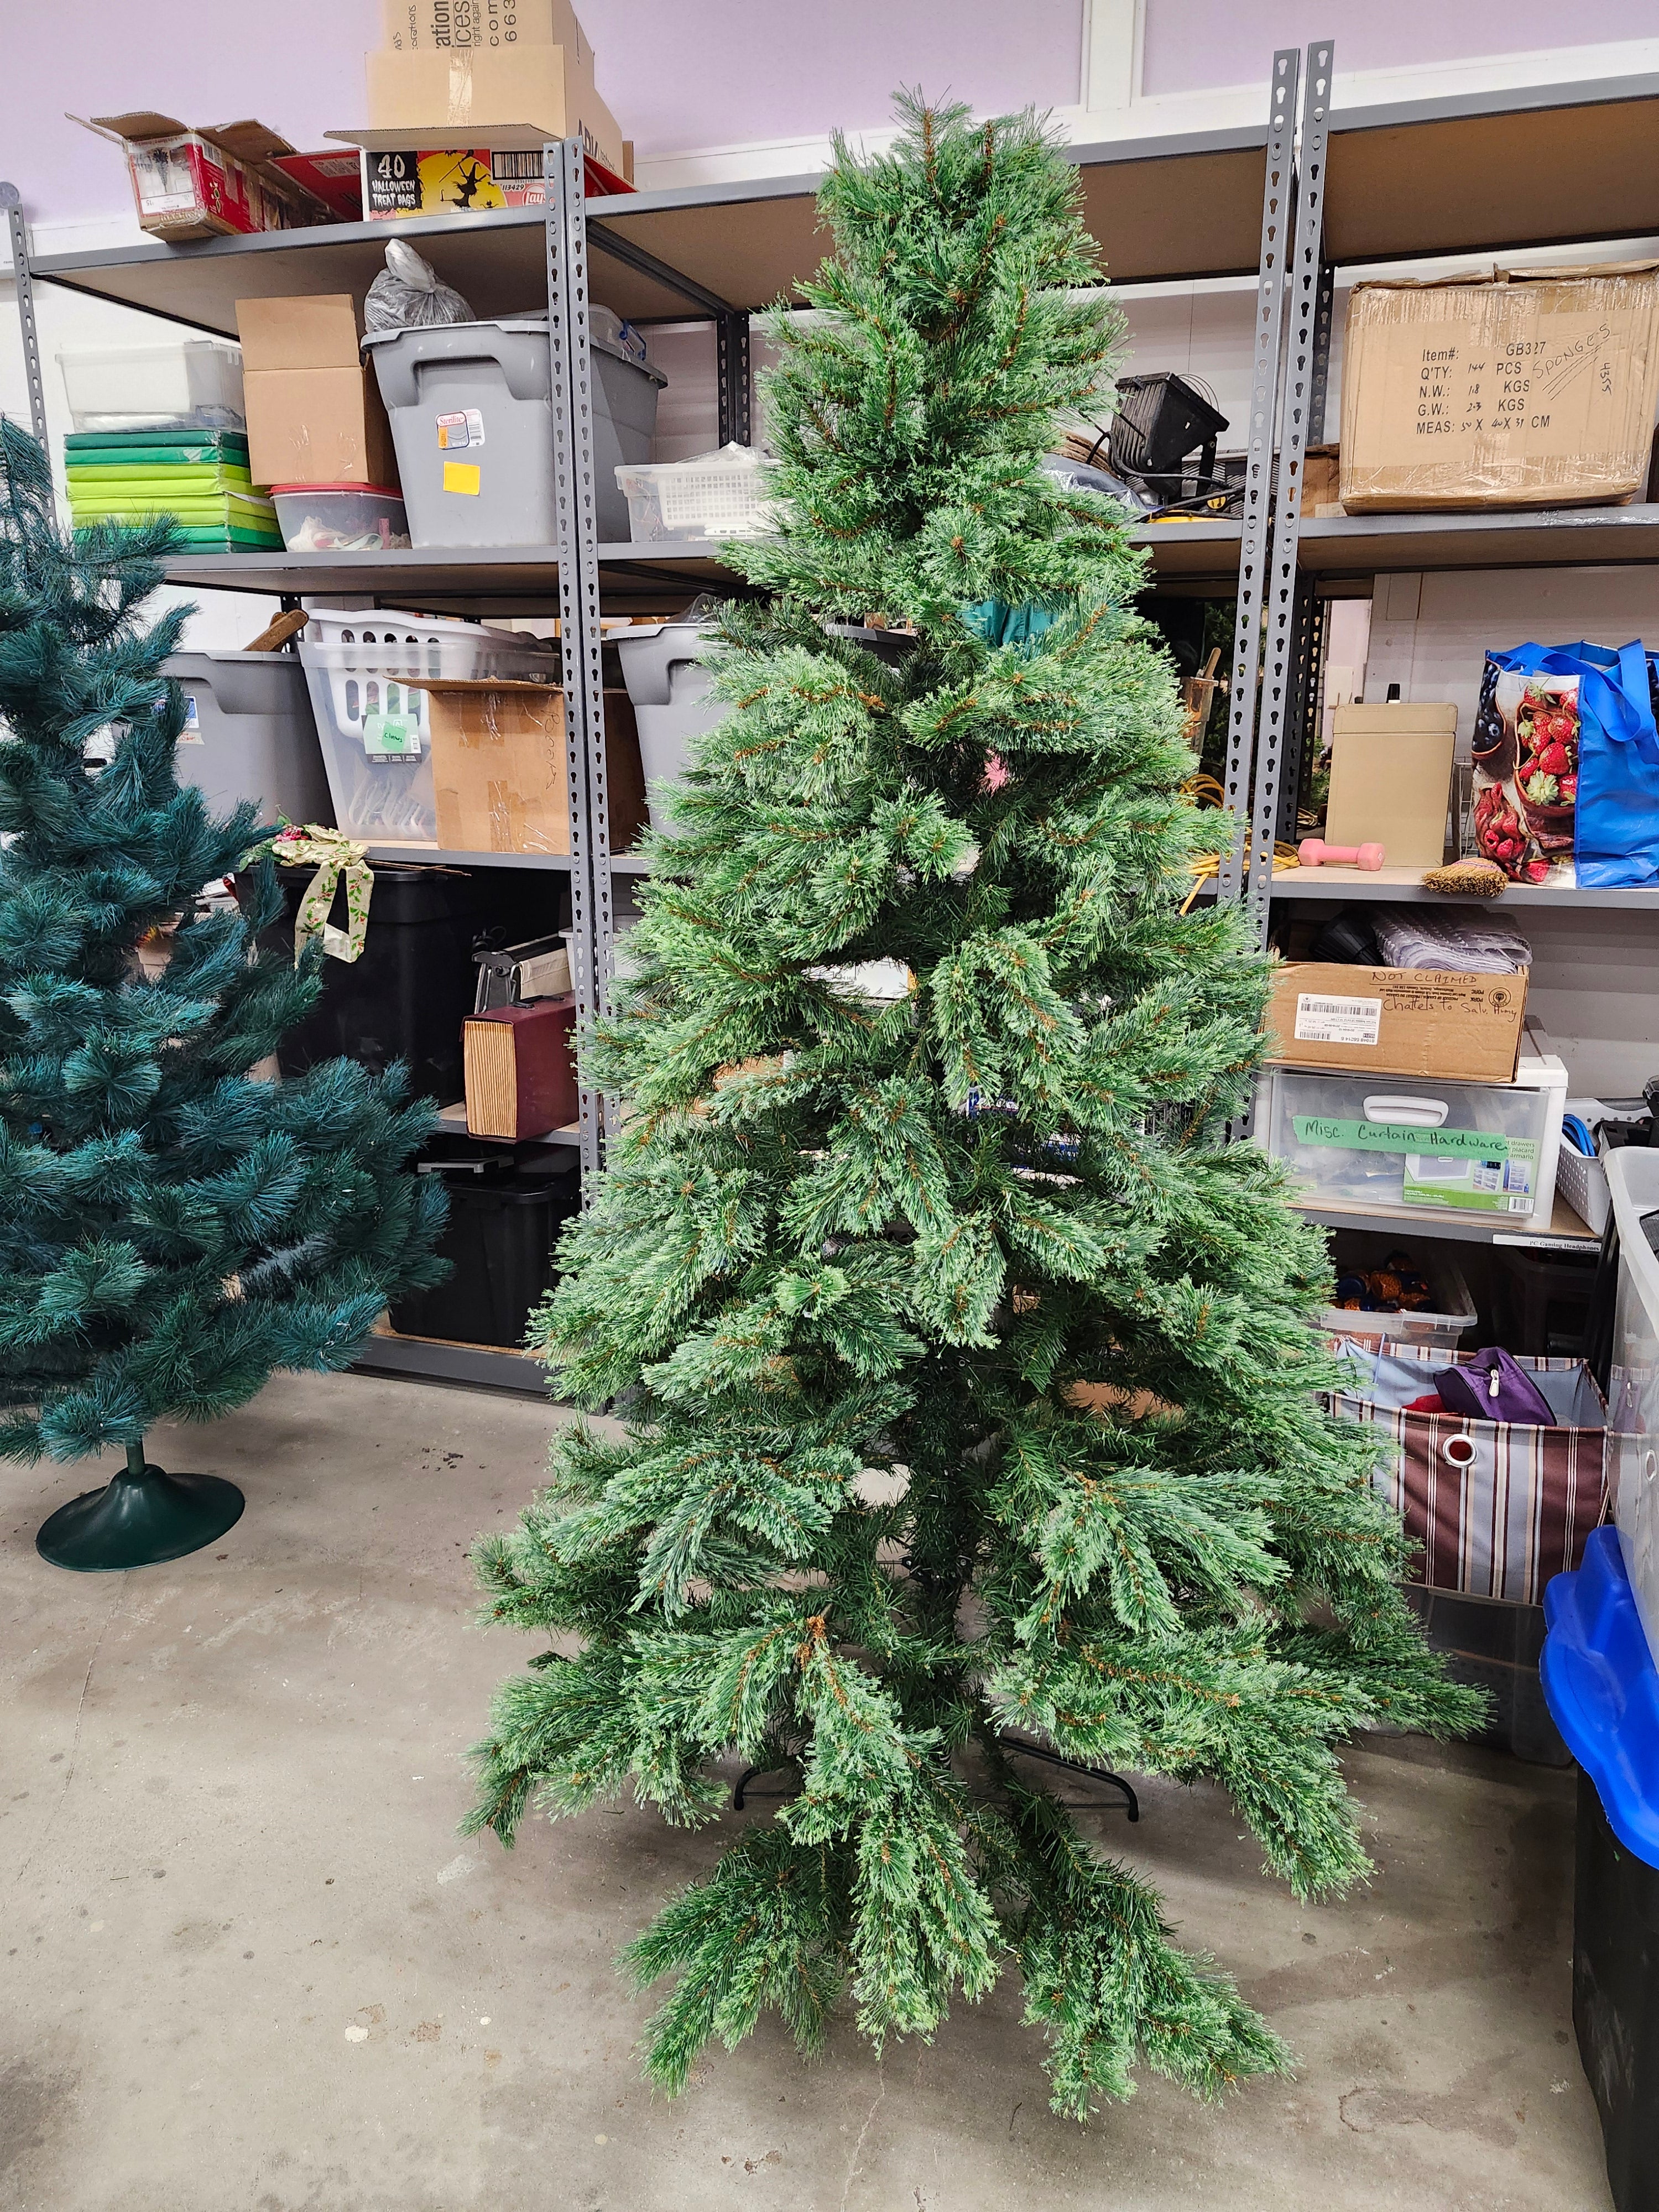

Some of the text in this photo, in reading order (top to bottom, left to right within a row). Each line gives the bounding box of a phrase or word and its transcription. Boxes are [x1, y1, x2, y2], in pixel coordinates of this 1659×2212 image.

[408, 4, 418, 50] orations
[472, 26, 483, 46] right
[377, 154, 405, 178] 40
[372, 179, 416, 193] HALLOWEEN
[372, 194, 416, 207] TREAT BAGS
[1422, 347, 1459, 362] Item#:
[1532, 323, 1610, 379] SPONGES
[1421, 362, 1522, 380] Q'TY: 144 PCS
[1419, 384, 1450, 399] N.W.:
[1504, 379, 1530, 393] KGS
[1418, 403, 1449, 416] G.W.:
[1498, 398, 1525, 412] KGS
[440, 416, 462, 425] Sterilite
[1416, 420, 1455, 435] MEAS:
[1475, 419, 1483, 431] X
[1503, 417, 1511, 430] X
[1531, 415, 1550, 428] CM
[1372, 971, 1477, 984] NOT CLAIMED
[1383, 996, 1434, 1011] Chattels
[1305, 1120, 1345, 1139] Misc.
[1357, 1125, 1416, 1142] Curtain
[1564, 1243, 1599, 1251] Headphones
